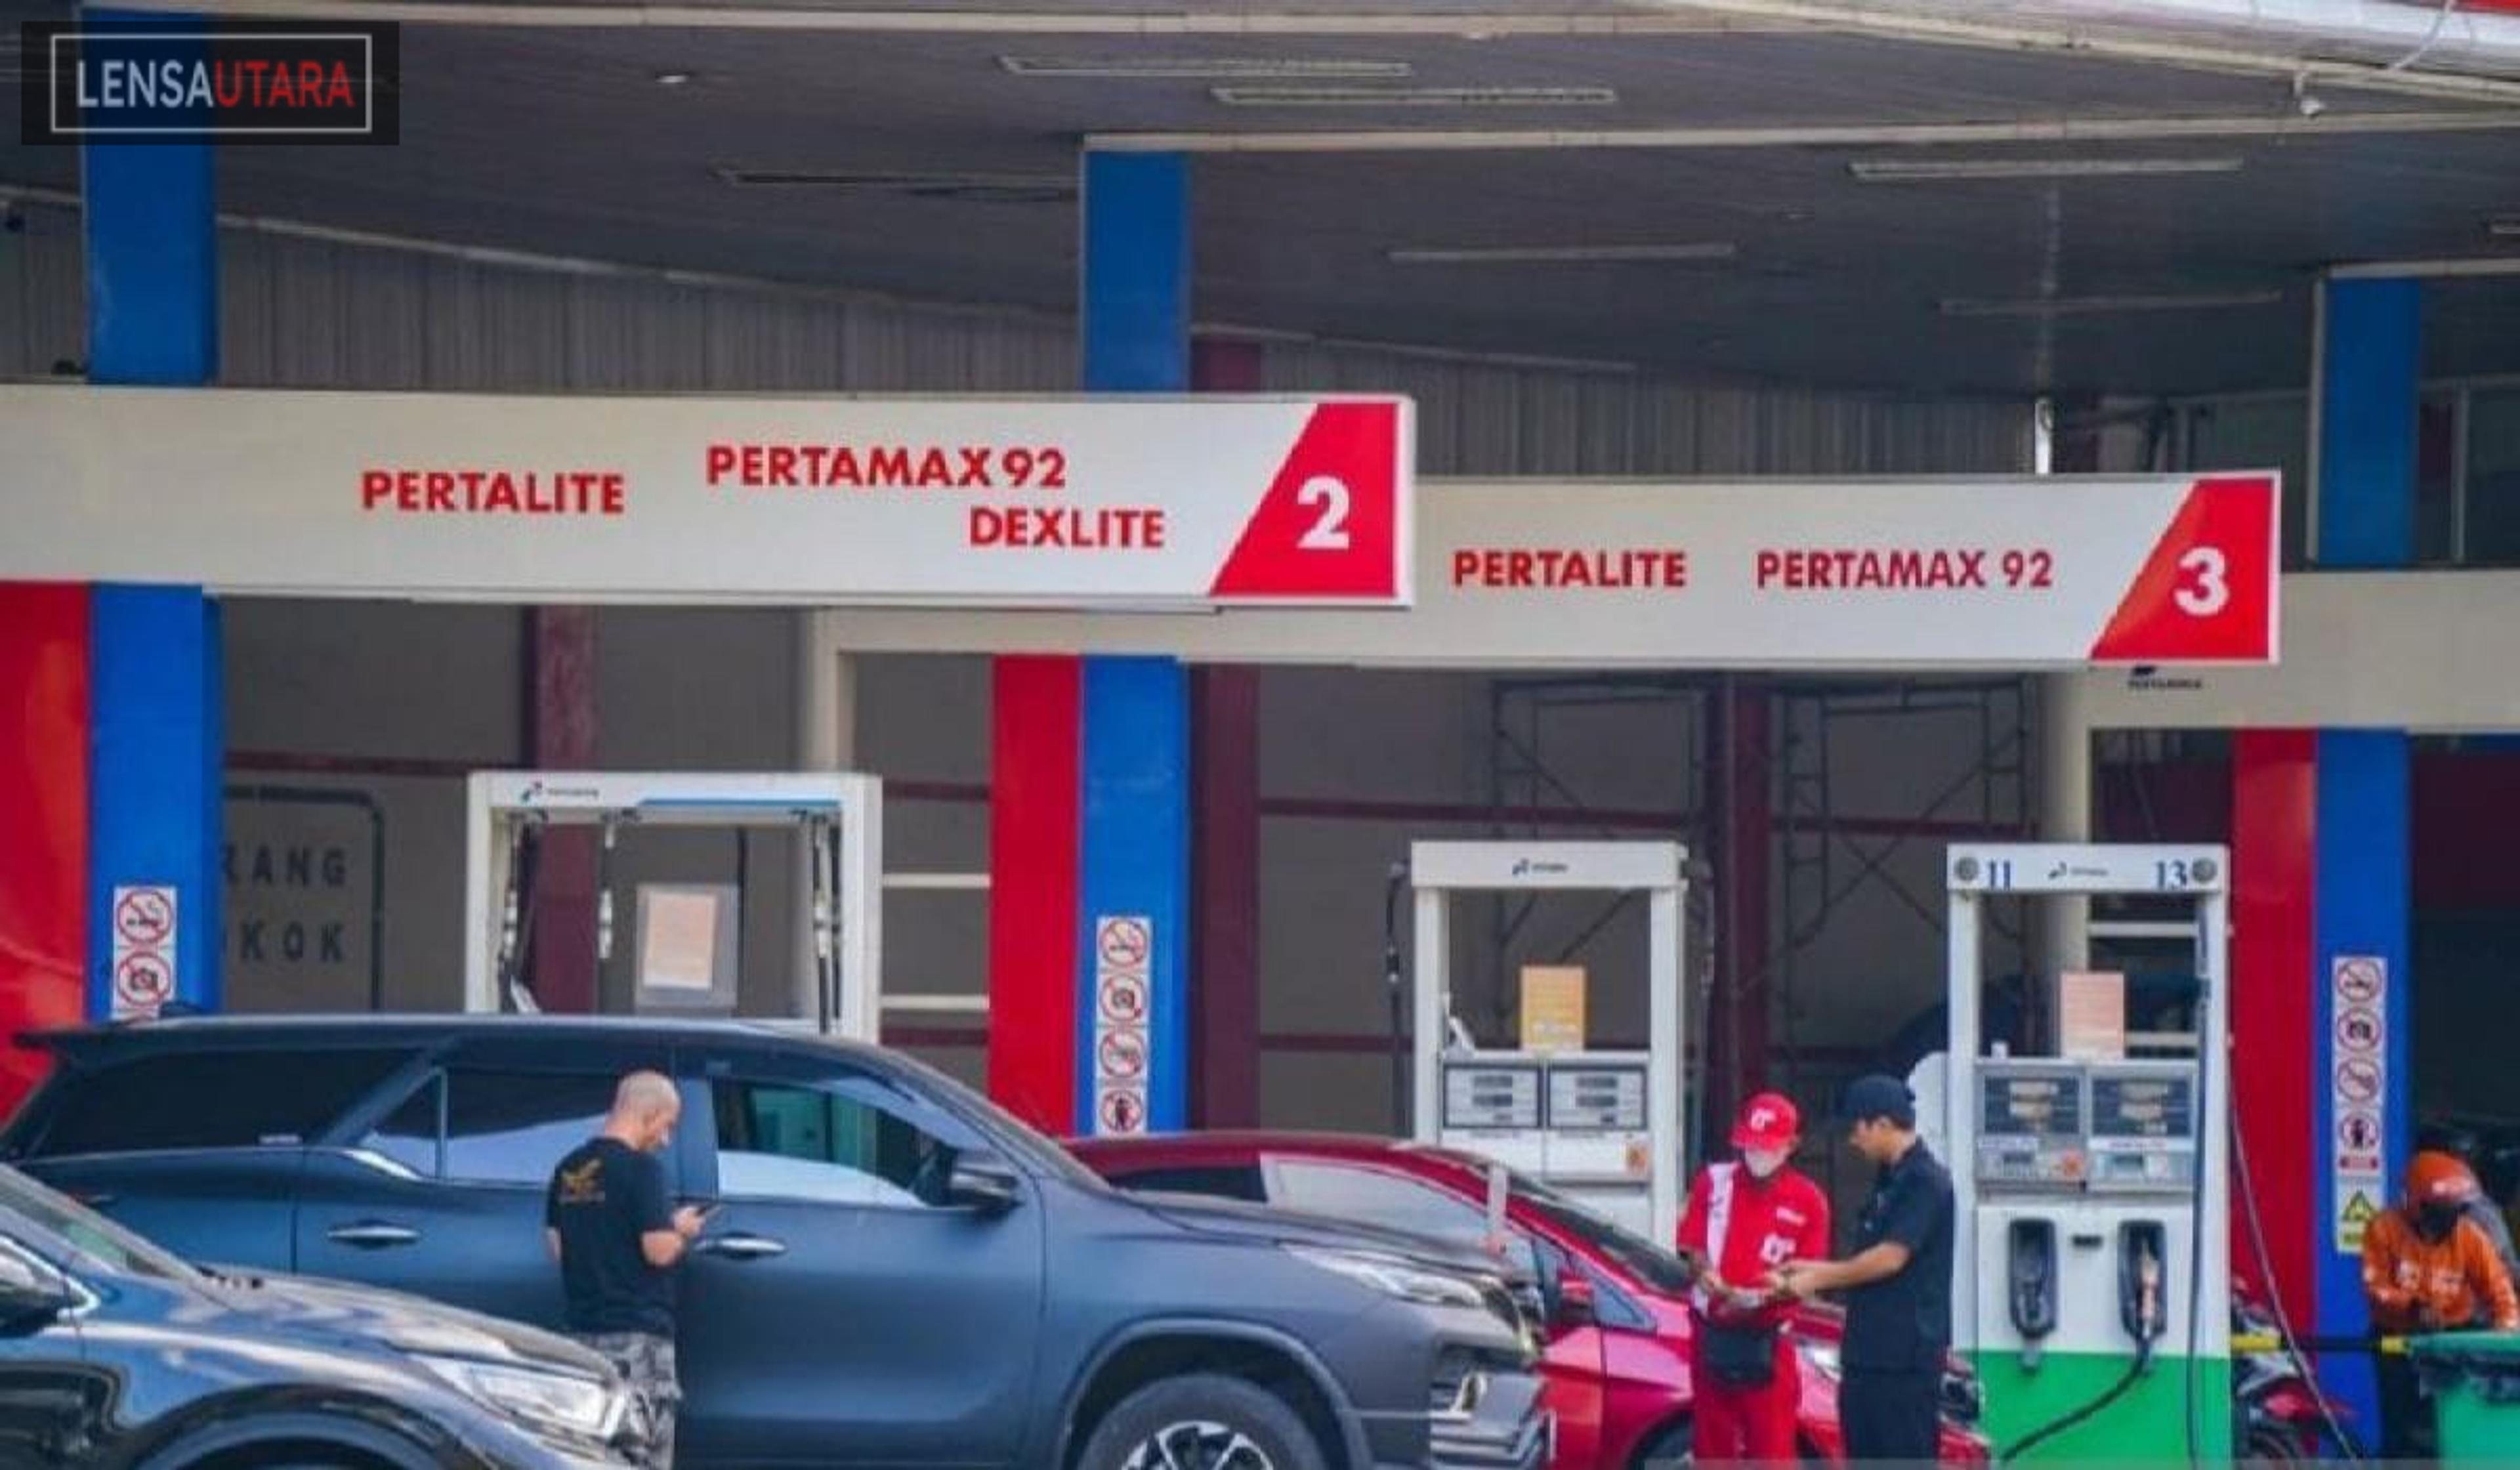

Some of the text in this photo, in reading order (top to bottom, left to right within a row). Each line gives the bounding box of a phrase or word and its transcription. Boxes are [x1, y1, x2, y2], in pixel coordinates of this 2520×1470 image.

[707, 445, 1066, 490] PERTAMAX 92
[362, 470, 624, 514] PERTALITE
[1297, 476, 1351, 550] 2
[969, 507, 1165, 549] DEXLITE
[1452, 550, 1687, 588] PERTALITE
[1757, 551, 2052, 588] PERTAMAX 92
[2175, 547, 2229, 616] 3
[1986, 859, 2012, 889] 11
[2155, 859, 2188, 889] 13
